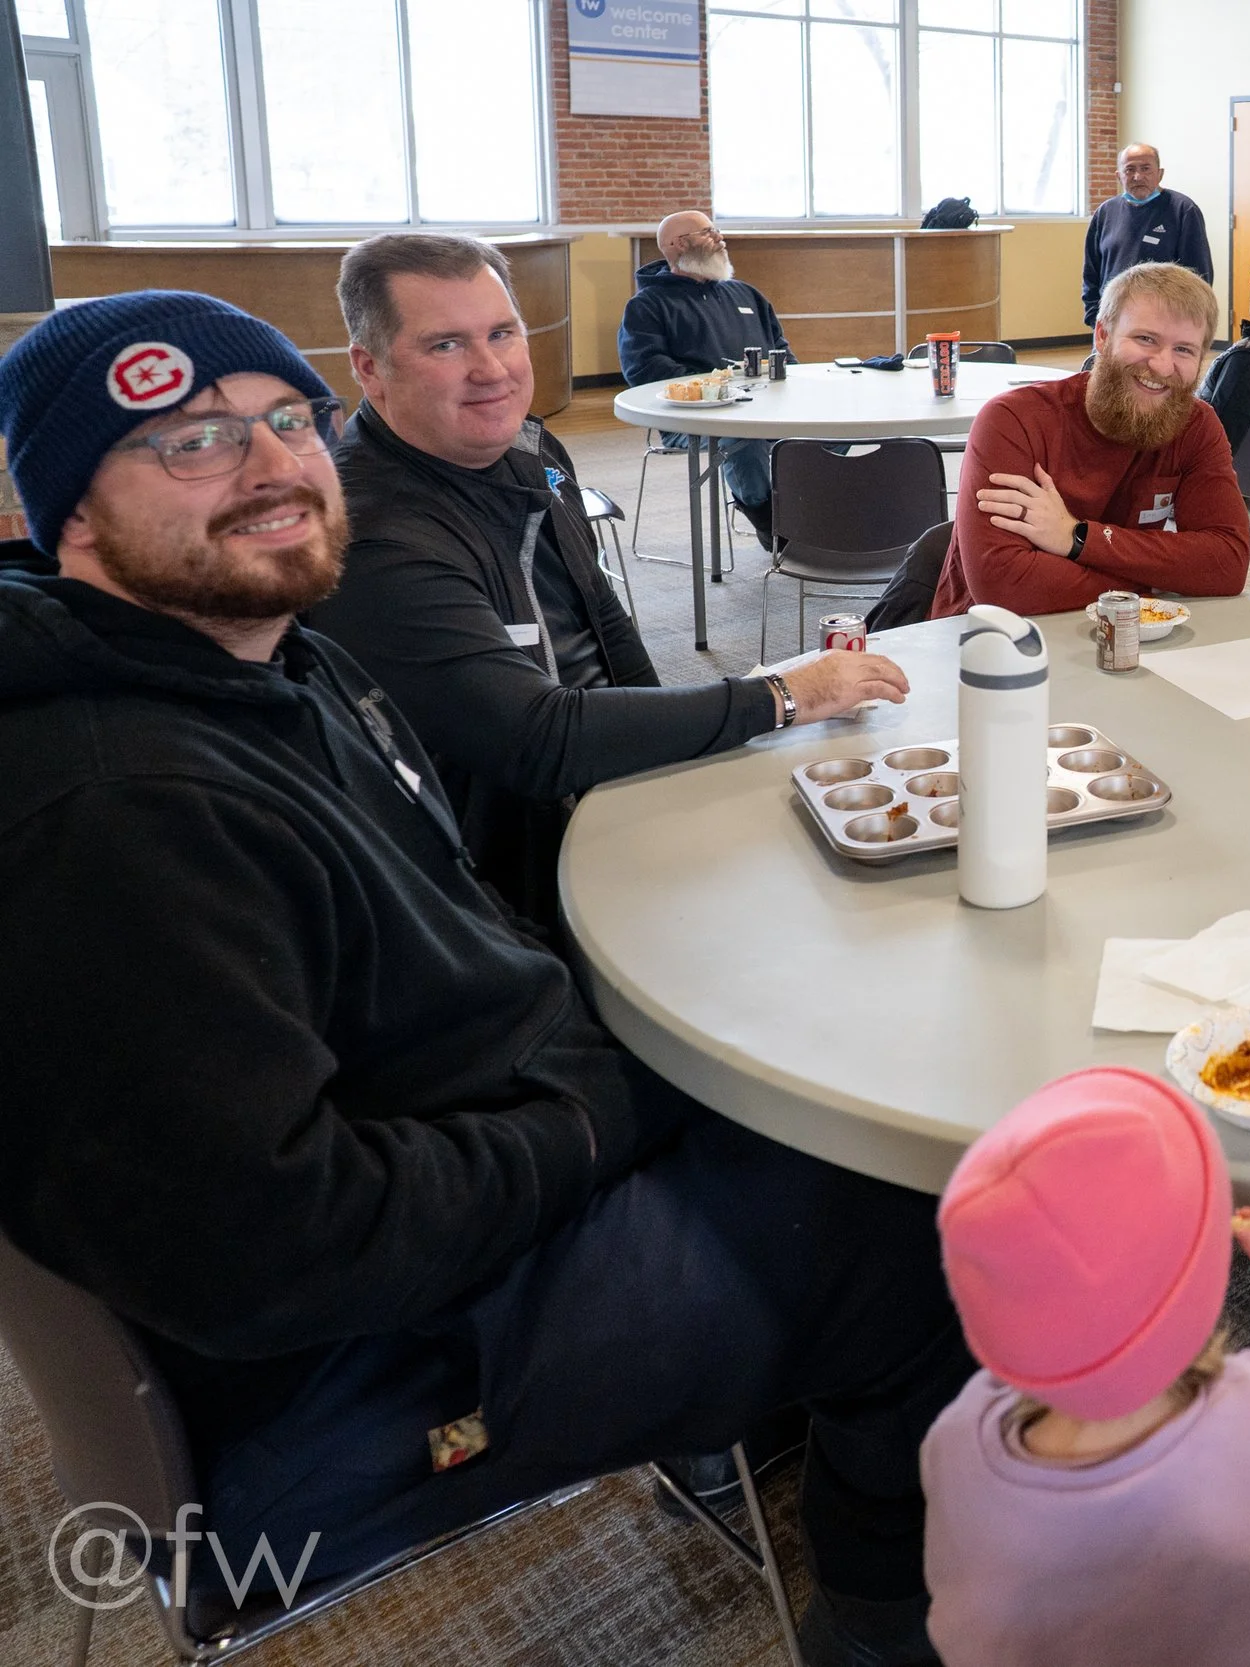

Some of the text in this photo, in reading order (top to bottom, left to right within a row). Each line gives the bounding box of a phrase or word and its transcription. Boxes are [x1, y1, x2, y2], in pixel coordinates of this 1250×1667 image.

[609, 6, 693, 26] welcome
[611, 24, 669, 40] center
[939, 341, 951, 394] CHICAGO
[825, 631, 865, 652] Co
